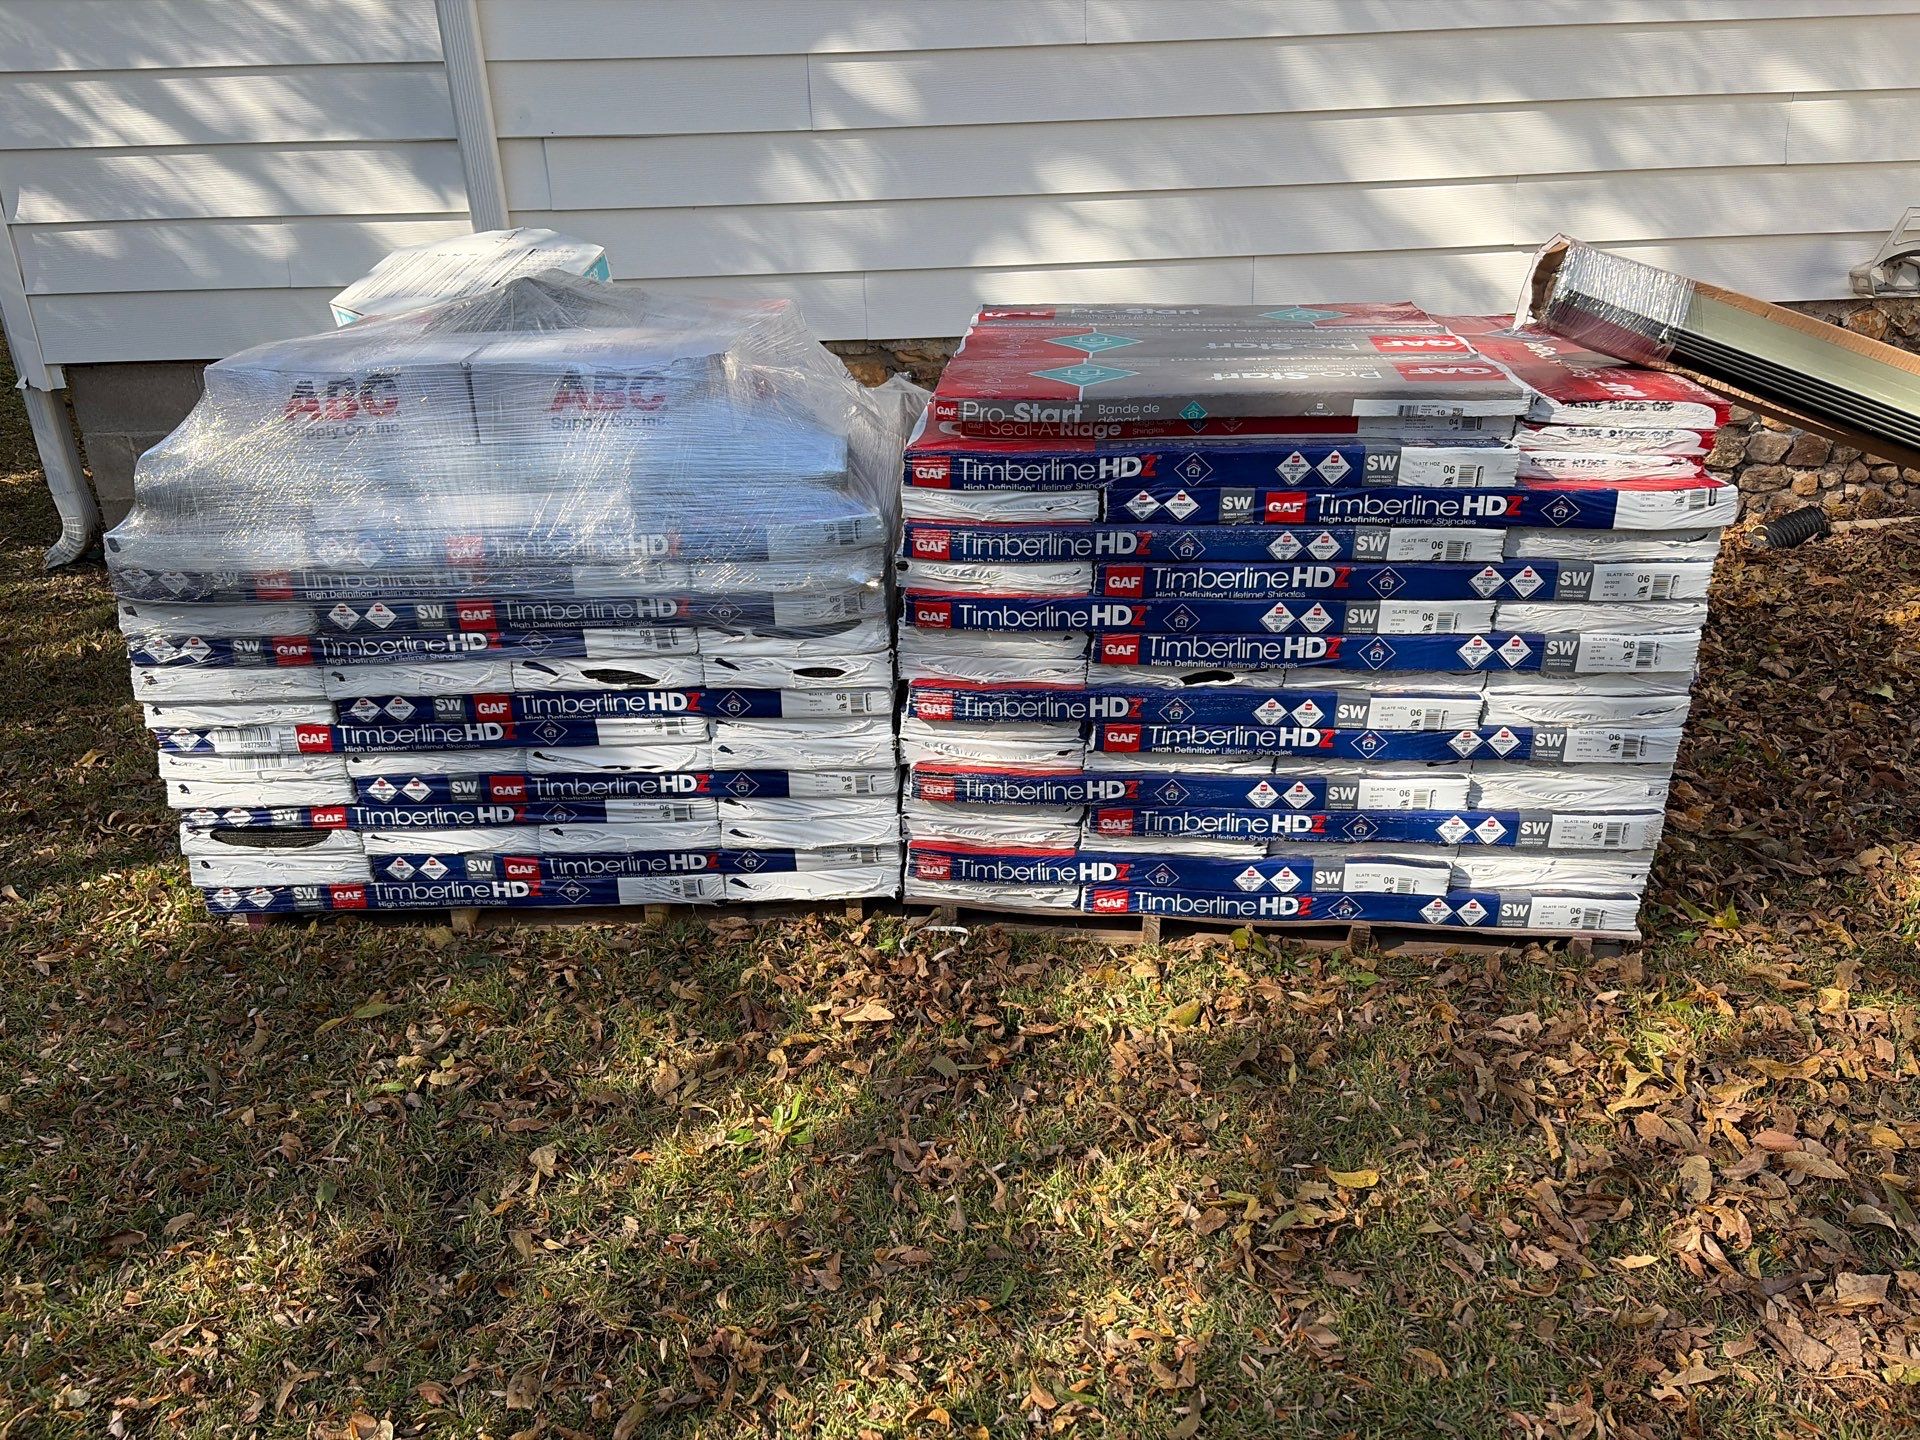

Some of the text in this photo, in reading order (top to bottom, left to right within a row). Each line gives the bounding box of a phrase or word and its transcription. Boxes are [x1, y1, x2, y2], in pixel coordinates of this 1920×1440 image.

[1205, 341, 1359, 351] Pro-Start
[1382, 339, 1456, 348] GAF
[1208, 367, 1492, 382] GAF Pro-Start
[282, 373, 400, 421] ABC
[550, 370, 666, 412] ABC
[936, 402, 1083, 422] GAF Pro-Start
[1098, 404, 1160, 415] Bande de
[990, 422, 1122, 439] Seal-A-Ridge
[915, 454, 1157, 482] GAF Timberline HDZ
[1366, 455, 1398, 471] SW
[1443, 465, 1456, 474] 06
[1222, 496, 1252, 511] SW
[1268, 493, 1525, 516] GAF Timberline HDZ
[1318, 516, 1342, 524] High
[1343, 516, 1390, 524] Definition
[915, 532, 1152, 556] GAF Timberline HDZ
[1356, 535, 1390, 551] SW
[1431, 540, 1444, 550] 06
[1108, 566, 1350, 589] GAF Timberline HDZ
[1559, 571, 1592, 587] SW
[1637, 574, 1650, 583] 06
[306, 590, 327, 599] High
[417, 604, 444, 620] SW
[460, 609, 492, 621] GAF
[500, 600, 634, 621] Timberline
[917, 604, 1148, 628] GAF Timberline HDZ
[1347, 608, 1378, 624] SW
[1422, 612, 1434, 622] 06
[509, 621, 531, 630] High
[232, 640, 259, 653] SW
[276, 645, 308, 656] GAF
[316, 637, 446, 657] Timberline
[1104, 636, 1342, 659] GAF Timberline HDZ
[1546, 640, 1579, 656] SW
[1623, 640, 1635, 649] 06
[478, 691, 704, 715] GAF Timberline HDZ
[835, 693, 847, 701] 06
[435, 698, 461, 712] SW
[920, 696, 1142, 718] GAF Timberline HDZ
[1337, 704, 1368, 719] SW
[1410, 708, 1423, 717] 06
[298, 721, 517, 744] GAF Timberline HDZ
[1106, 726, 1334, 748] GAF Timberline HDZ
[1534, 732, 1564, 748] SW
[1608, 733, 1621, 741] 06
[492, 774, 712, 796] GAF Timberline HDZ
[841, 775, 852, 783] 06
[451, 780, 478, 794] SW
[923, 779, 1139, 801] GAF Timberline HDZ
[1328, 786, 1358, 801] SW
[1399, 789, 1411, 798] 06
[313, 806, 528, 826] GAF Timberline HDZ
[1100, 810, 1326, 833] GAF Timberline HDZ
[1520, 821, 1550, 835] SW
[1592, 822, 1604, 830] 06
[467, 859, 493, 873] SW
[507, 853, 720, 875] GAF Timberline HDZ
[957, 859, 1082, 882] Timberline
[1079, 862, 1131, 882] HDZ
[669, 879, 680, 887] 06
[1314, 871, 1343, 885] SW
[1383, 876, 1395, 885] 06
[294, 887, 318, 900] SW
[333, 881, 544, 901] GAF Timberline HDZ
[1096, 898, 1127, 908] GAF
[1135, 891, 1257, 916] Timberline
[1260, 896, 1313, 916] HDZ
[1501, 903, 1530, 917] SW
[1569, 907, 1582, 916] 06
